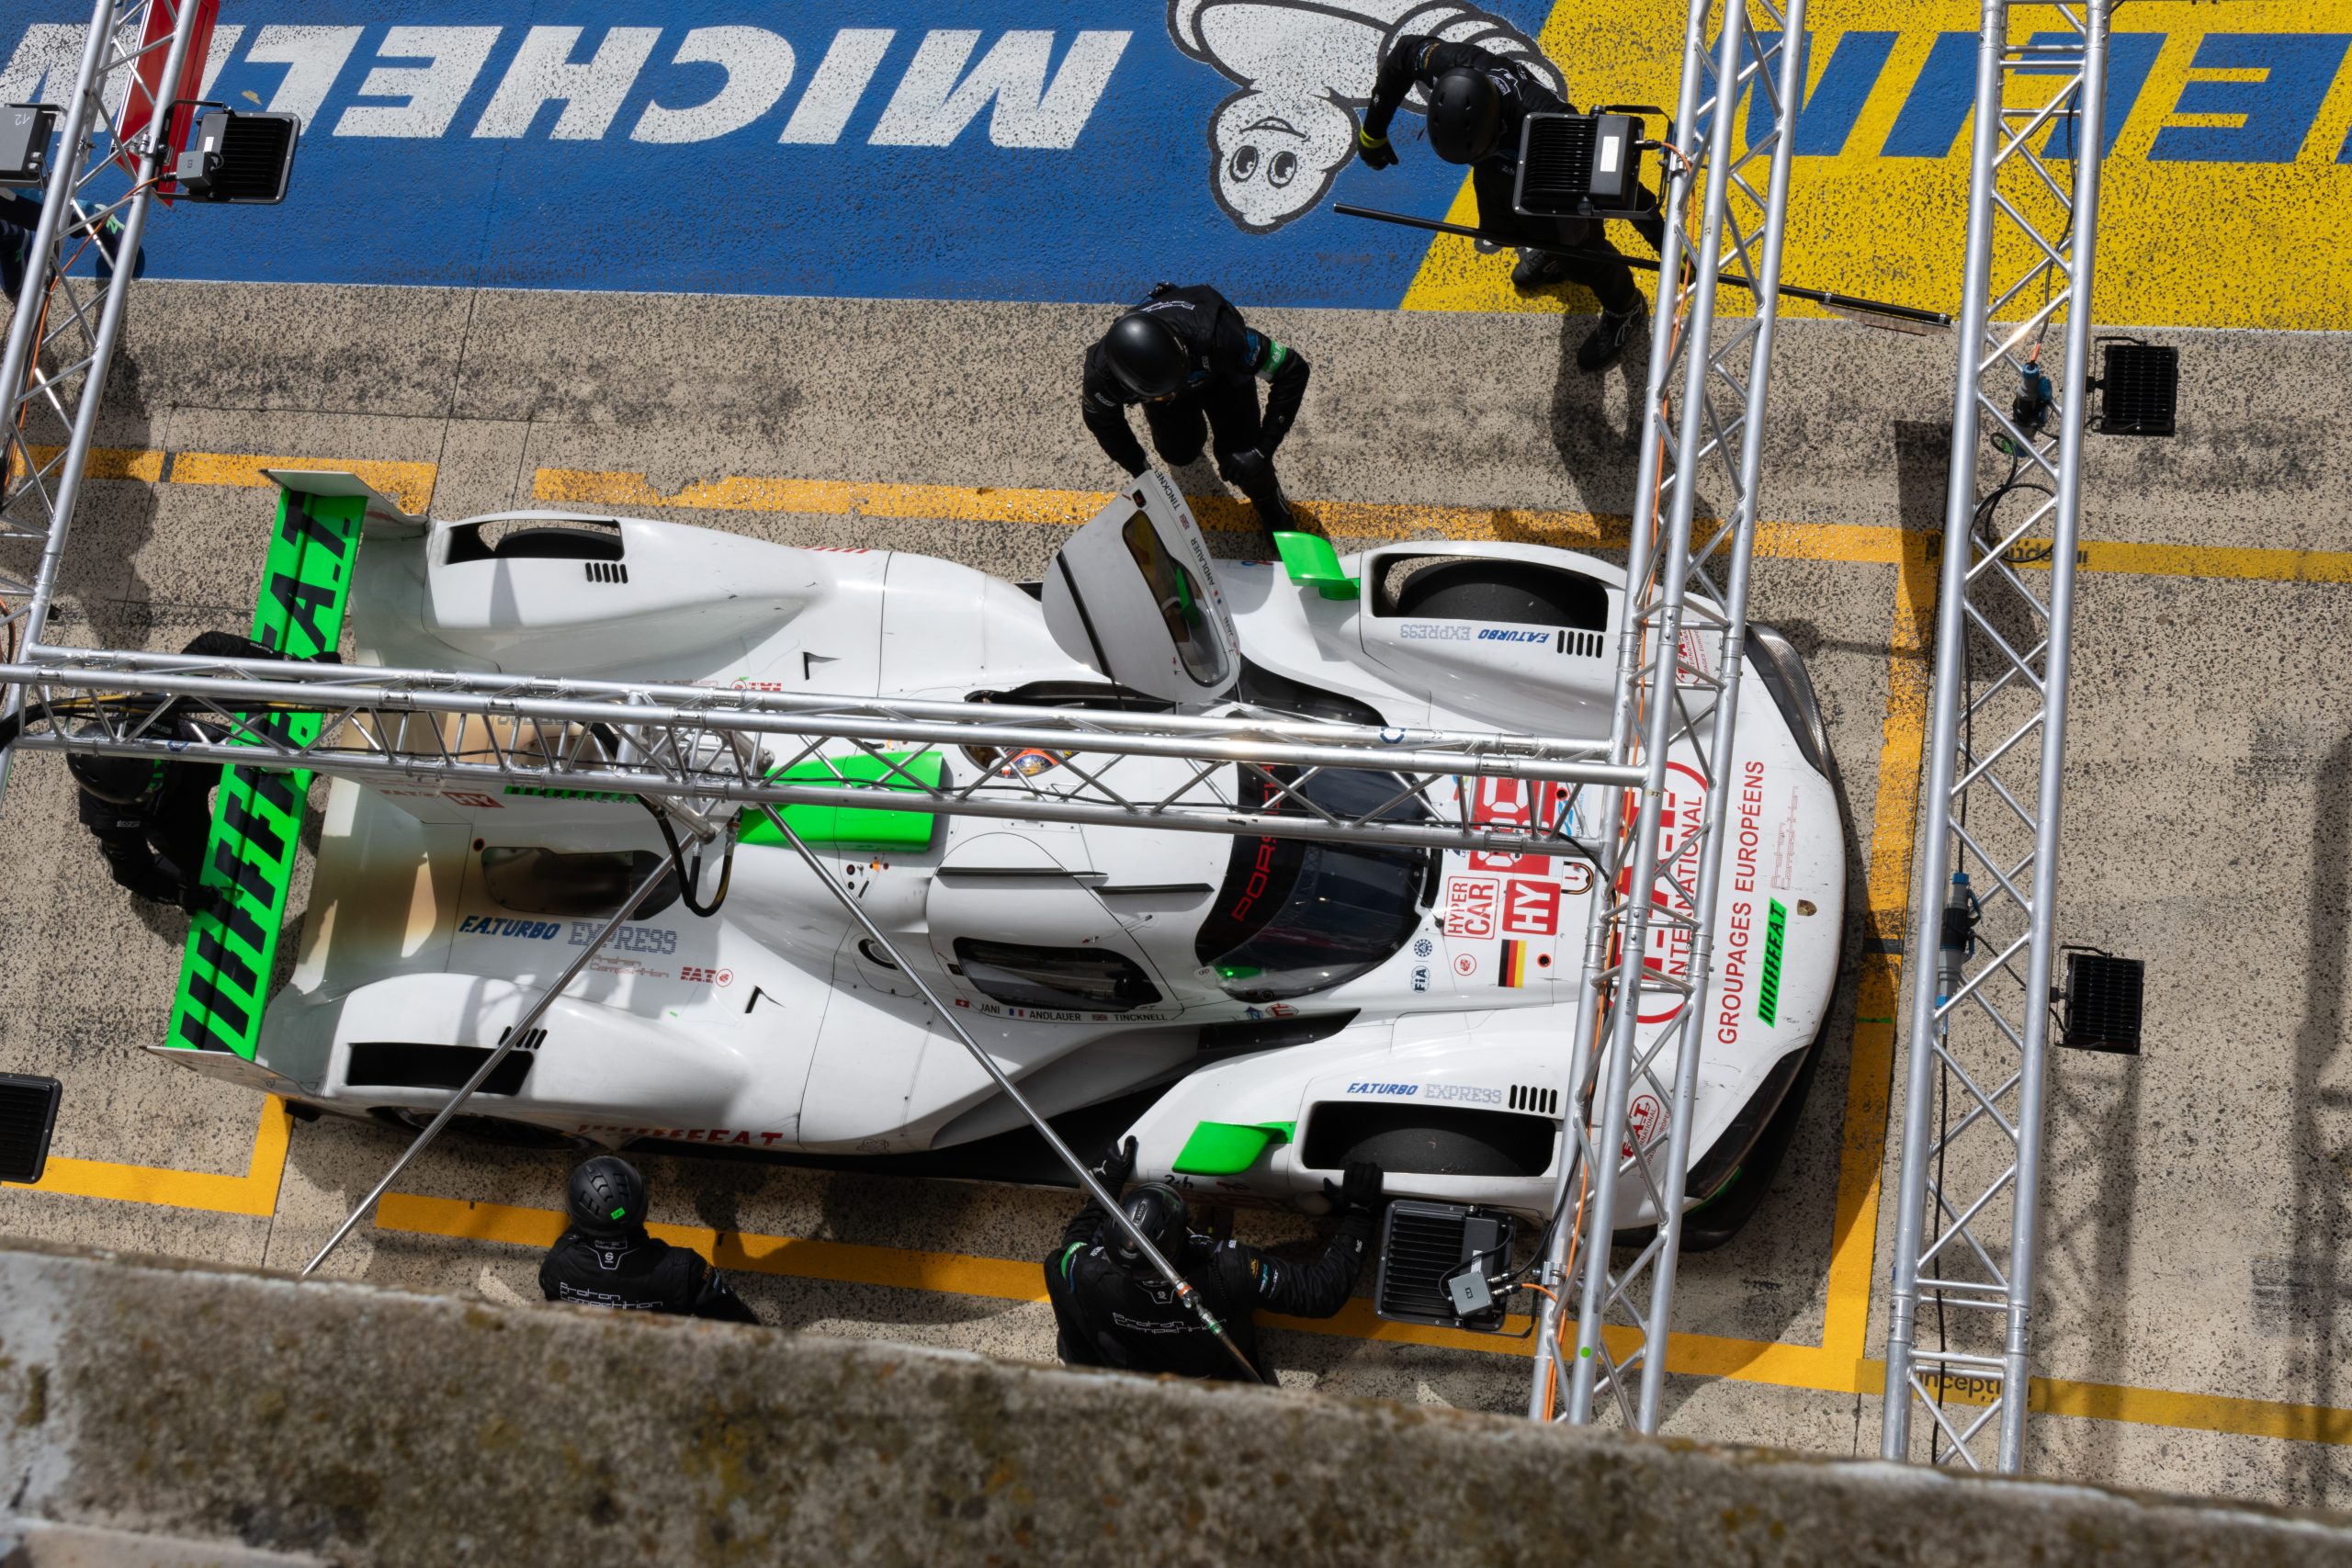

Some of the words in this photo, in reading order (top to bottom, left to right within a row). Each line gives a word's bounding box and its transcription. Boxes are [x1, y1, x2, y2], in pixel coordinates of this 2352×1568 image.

[1699, 31, 2352, 164] ELIN
[1190, 536, 1215, 586] ANDLAUER
[1399, 623, 1472, 641] EXPRESS
[1733, 760, 1765, 893] EUROPÉENS
[1447, 883, 1468, 934] HYPER
[1464, 884, 1494, 935] CAR
[1511, 882, 1551, 931] HY
[1717, 901, 1752, 1044] GROUPAGES
[979, 1003, 1001, 1014] JANI
[1029, 1010, 1081, 1022] ANDLAUER
[1113, 1013, 1168, 1022] TINCKNELL
[1424, 1083, 1502, 1105] EXPRESS
[560, 1280, 622, 1301] Proton
